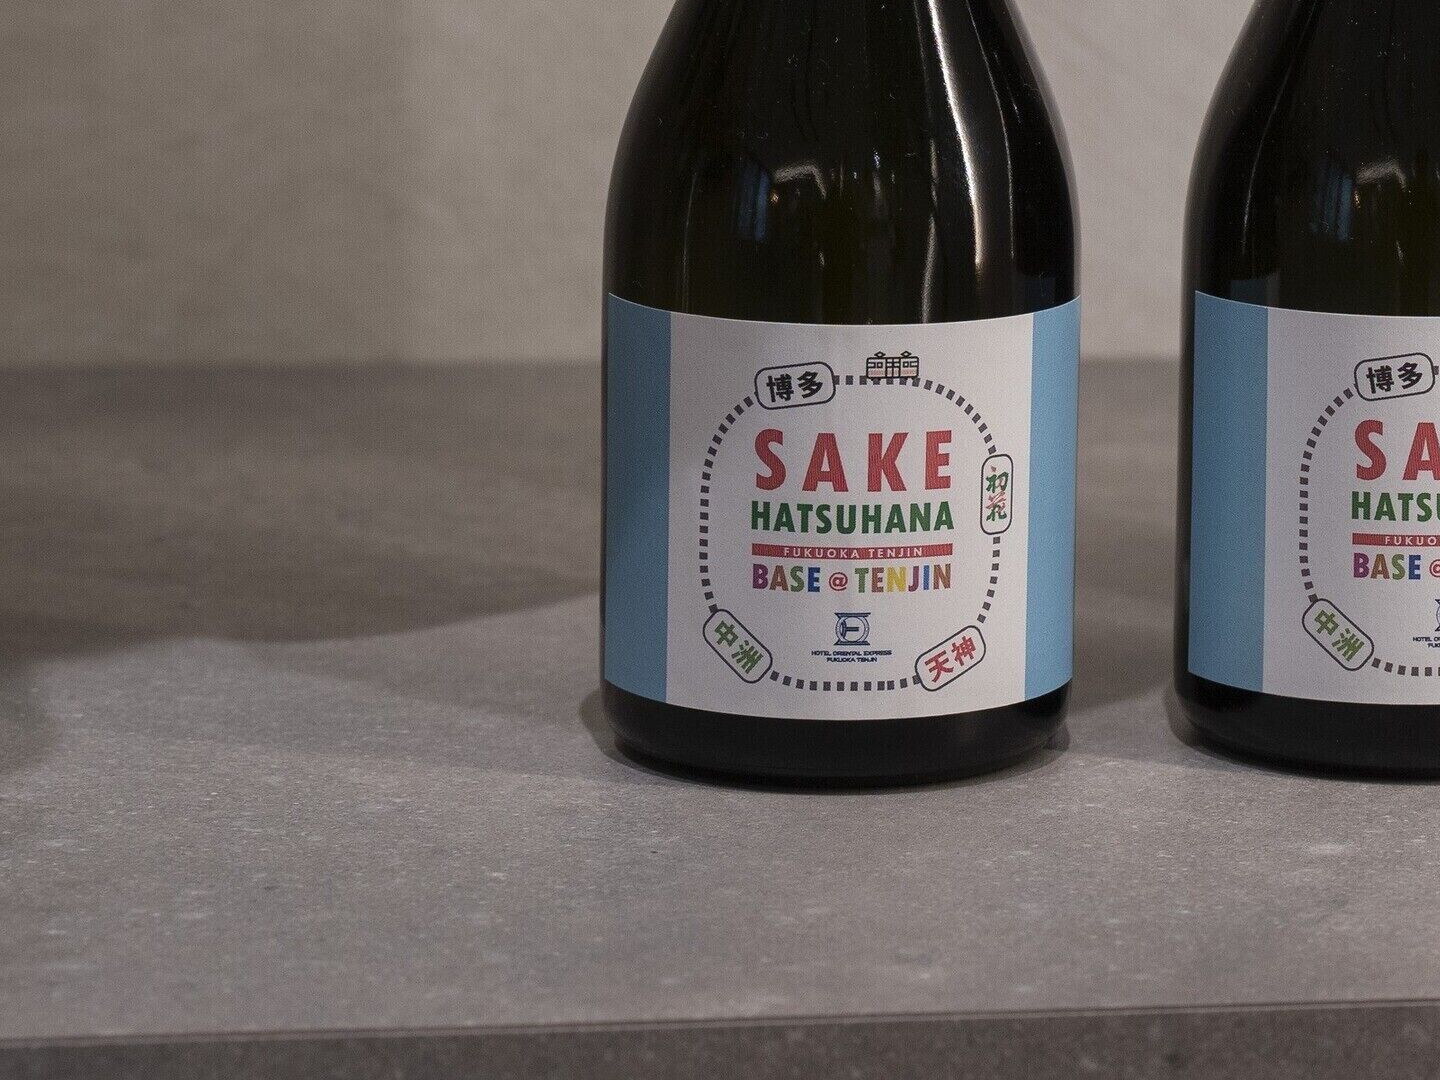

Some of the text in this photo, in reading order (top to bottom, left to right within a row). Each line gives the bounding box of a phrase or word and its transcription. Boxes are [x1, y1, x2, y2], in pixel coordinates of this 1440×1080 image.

[766, 371, 824, 402] 博多
[1366, 362, 1424, 394] 博多
[754, 428, 953, 493] SAKE
[751, 500, 955, 535] HATSUHANA
[783, 546, 924, 559] FUKUOKA TENJIN
[1353, 553, 1421, 580] BASE
[753, 562, 952, 593] BASE @ TENJIN
[714, 620, 764, 674] 中洲
[1313, 608, 1365, 662] 中洲
[924, 636, 978, 682] 天神
